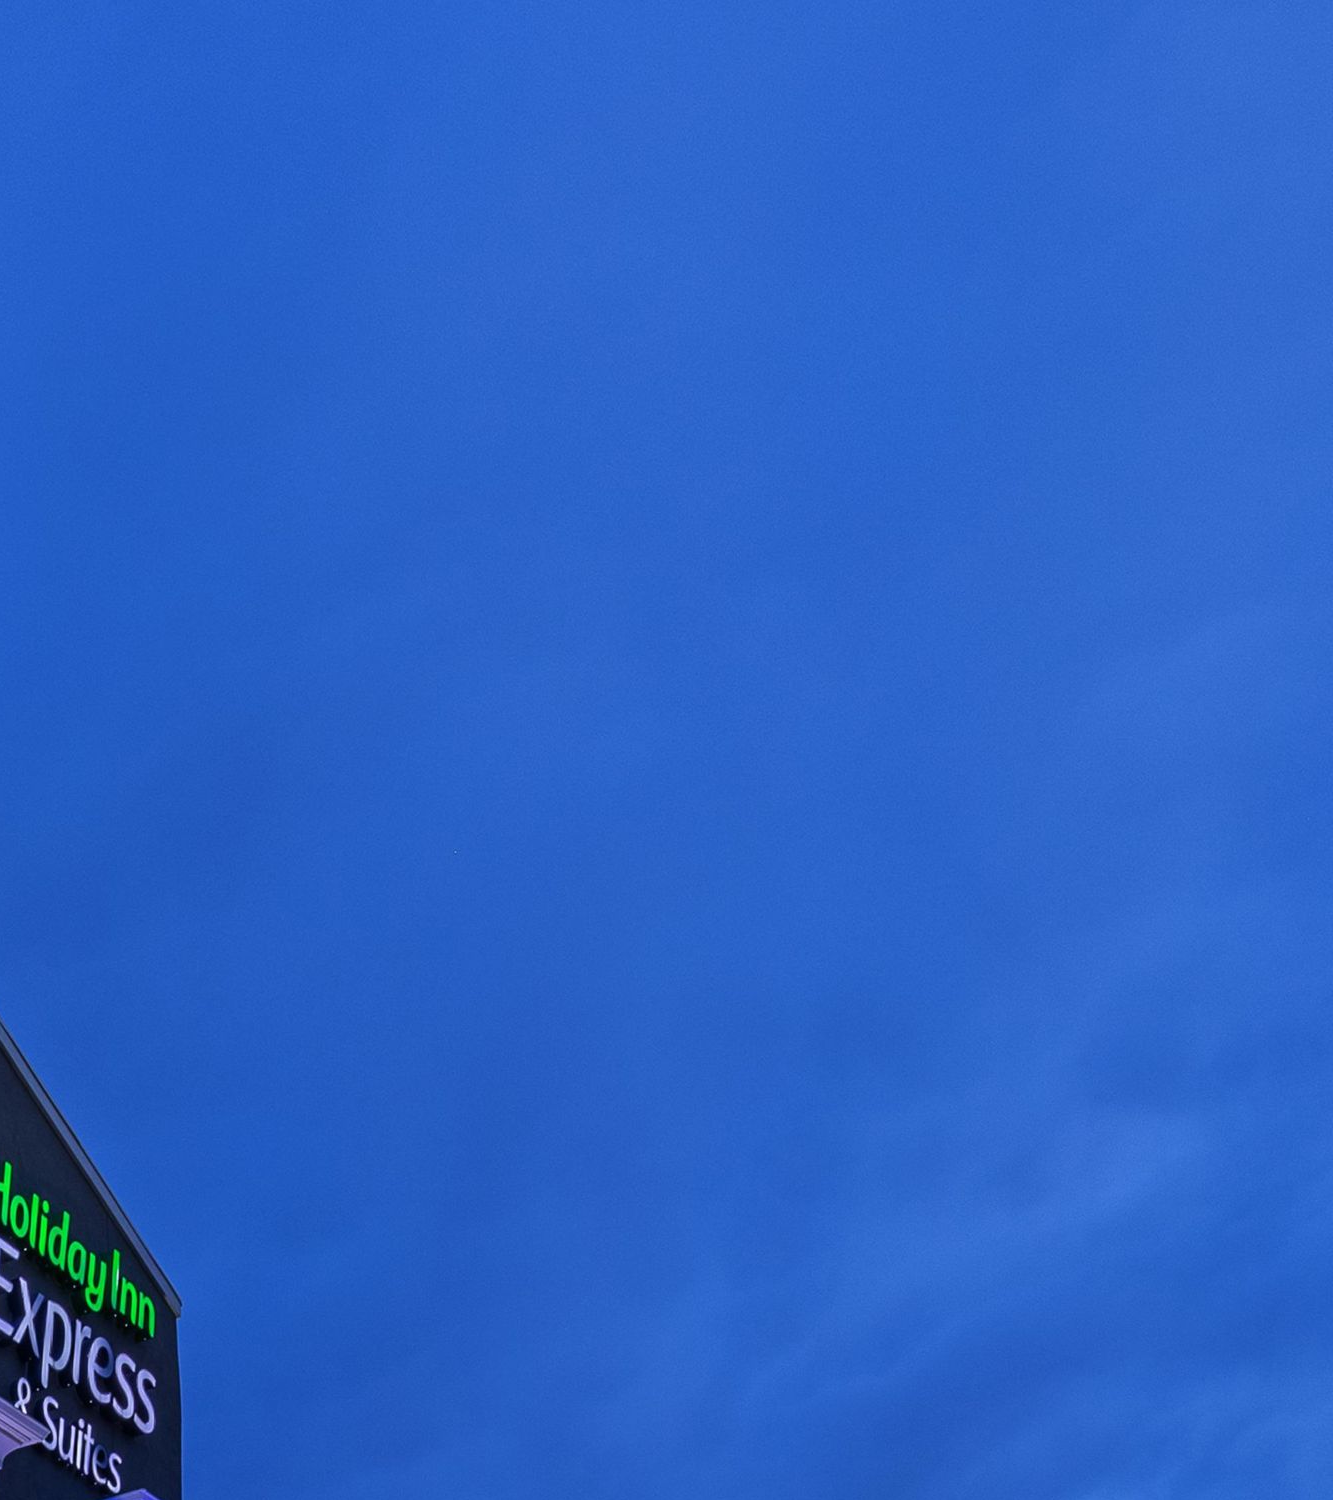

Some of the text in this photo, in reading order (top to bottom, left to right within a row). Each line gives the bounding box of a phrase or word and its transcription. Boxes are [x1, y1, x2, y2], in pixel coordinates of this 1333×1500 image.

[111, 1249, 156, 1338] Inn
[14, 1376, 123, 1493] & Suites
